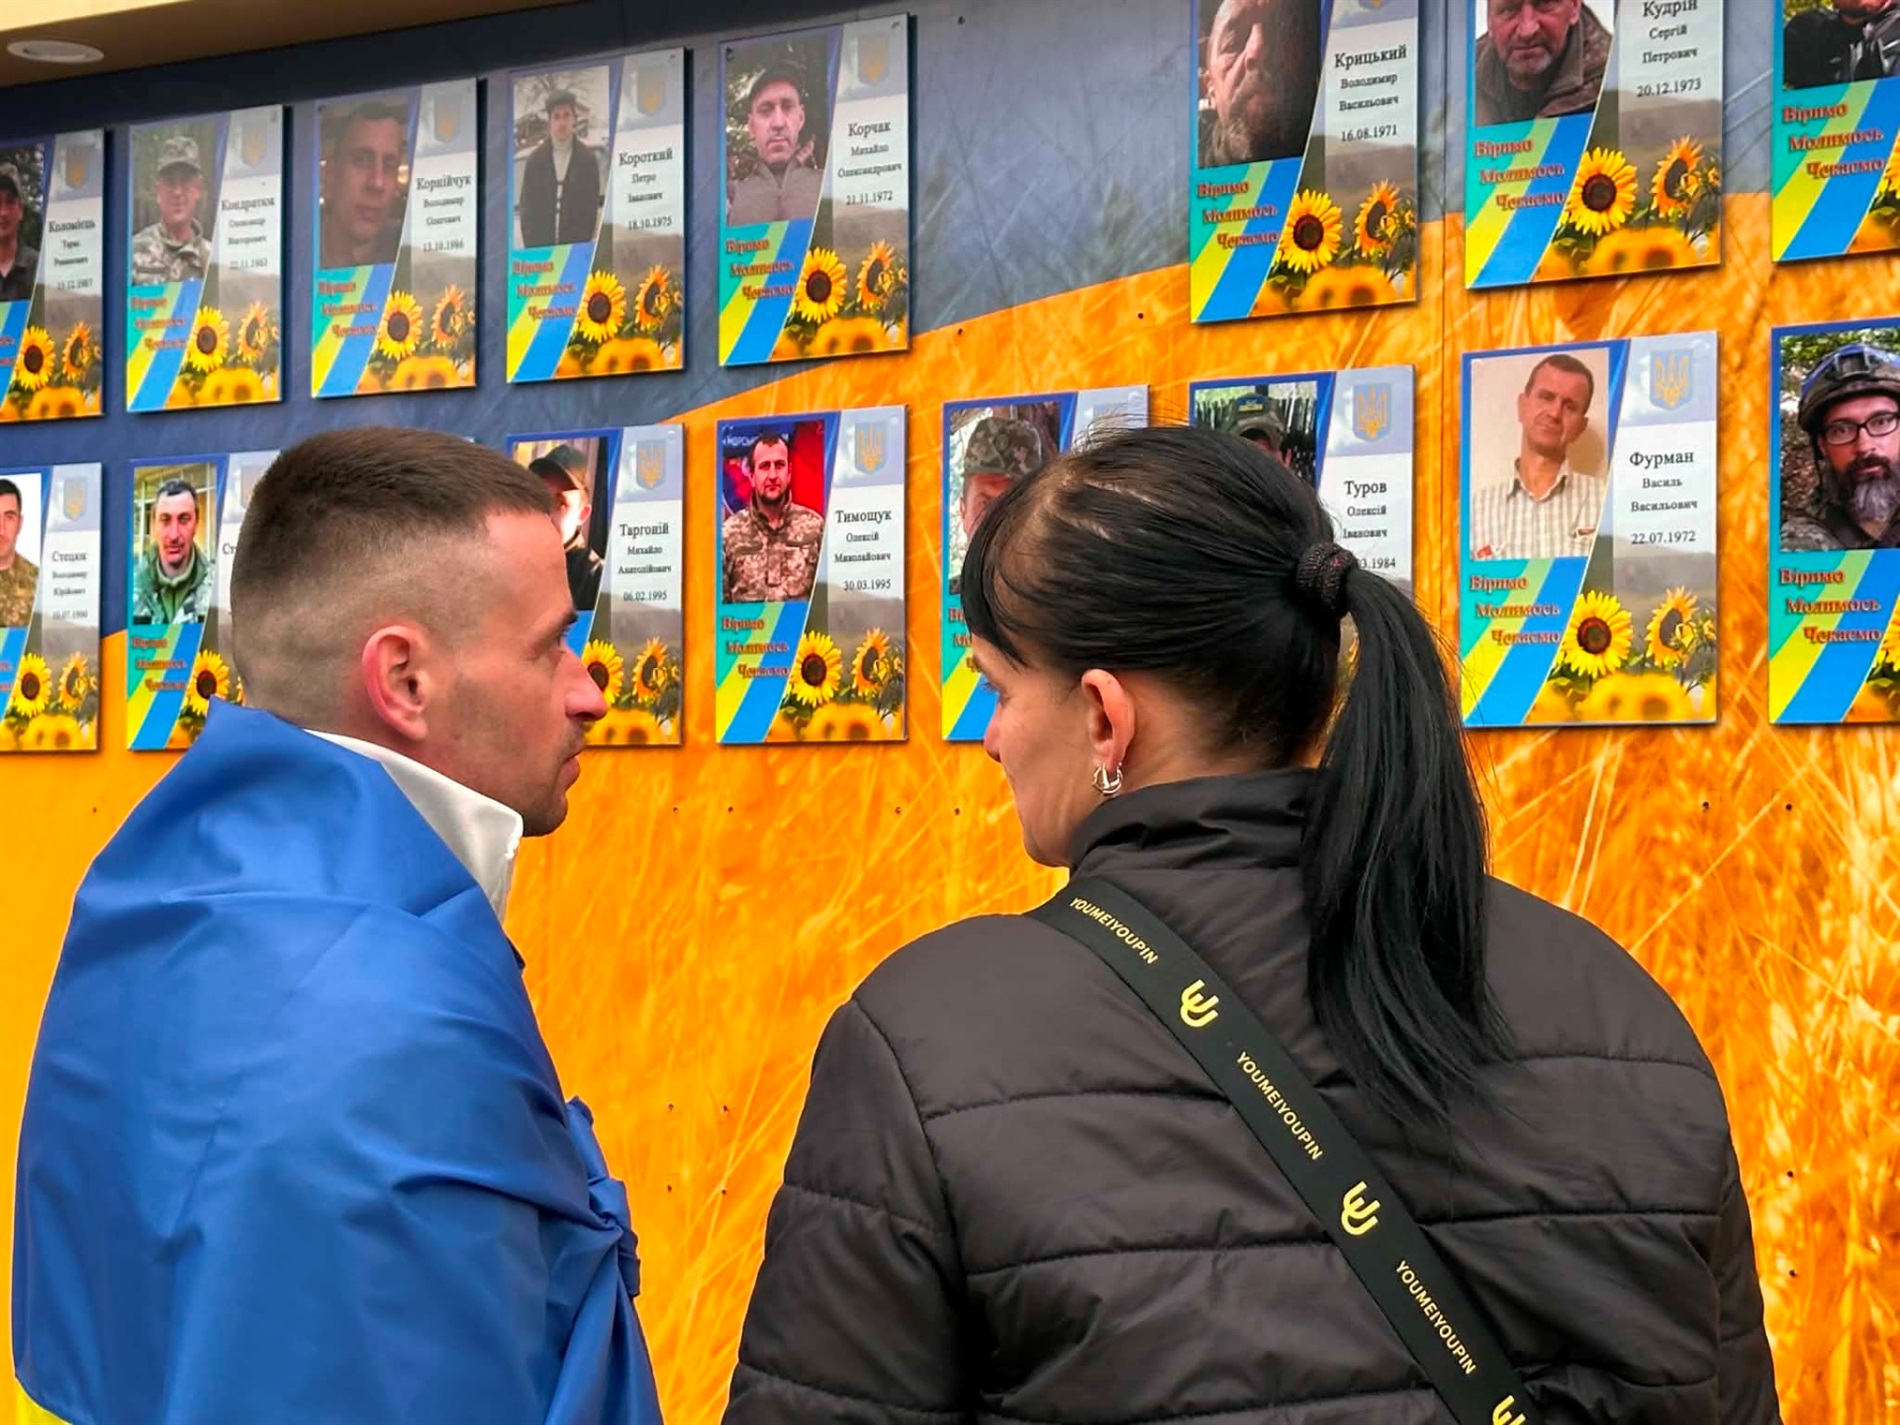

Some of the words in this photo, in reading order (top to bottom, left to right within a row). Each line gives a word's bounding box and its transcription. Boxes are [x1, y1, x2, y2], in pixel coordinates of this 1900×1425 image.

[1642, 0, 1698, 19] Кудрін
[1649, 24, 1688, 40] Сергій
[1334, 44, 1407, 70] Крицький
[1642, 48, 1698, 64] Петрович
[1341, 74, 1397, 89] Володимир
[1636, 78, 1701, 97] 20.12.1973
[1339, 96, 1399, 111] Васильович
[1782, 103, 1848, 125] Віримо
[848, 122, 891, 138] Корчак
[1341, 124, 1397, 142] 16.08.1971
[1789, 128, 1884, 151] Молимось
[619, 147, 673, 167] Короткий
[851, 144, 889, 156] Михайло
[1475, 139, 1533, 158] Віримо
[1807, 158, 1884, 180] Чекаємо
[416, 175, 472, 192] Корнійчук
[1197, 182, 1249, 199] Віримо
[846, 191, 893, 206] 21.11.1972
[1629, 452, 1694, 469] Фурман
[1344, 481, 1387, 498] Туров
[1642, 478, 1683, 489] Василь
[1347, 505, 1387, 517] Олексій
[1631, 500, 1698, 512] Васильович
[835, 510, 892, 524] Тимощук
[619, 522, 669, 539] Таргоній
[846, 531, 879, 542] Олексій
[1343, 529, 1388, 539] Іванович
[1631, 530, 1696, 545] 22.07.1972
[843, 579, 891, 591] 30.03.1995
[1469, 575, 1529, 594] Віримо
[1780, 568, 1845, 589] Віримо
[1475, 603, 1560, 619] Молимось
[1786, 598, 1881, 615] Молимось
[1803, 626, 1882, 644] Чекаємо
[1069, 897, 1158, 964] YOUMEIYOUPIN
[1236, 1051, 1322, 1160] YOUMEIYOUPIN
[1395, 1260, 1477, 1375] YOUMEIYOUPIN
